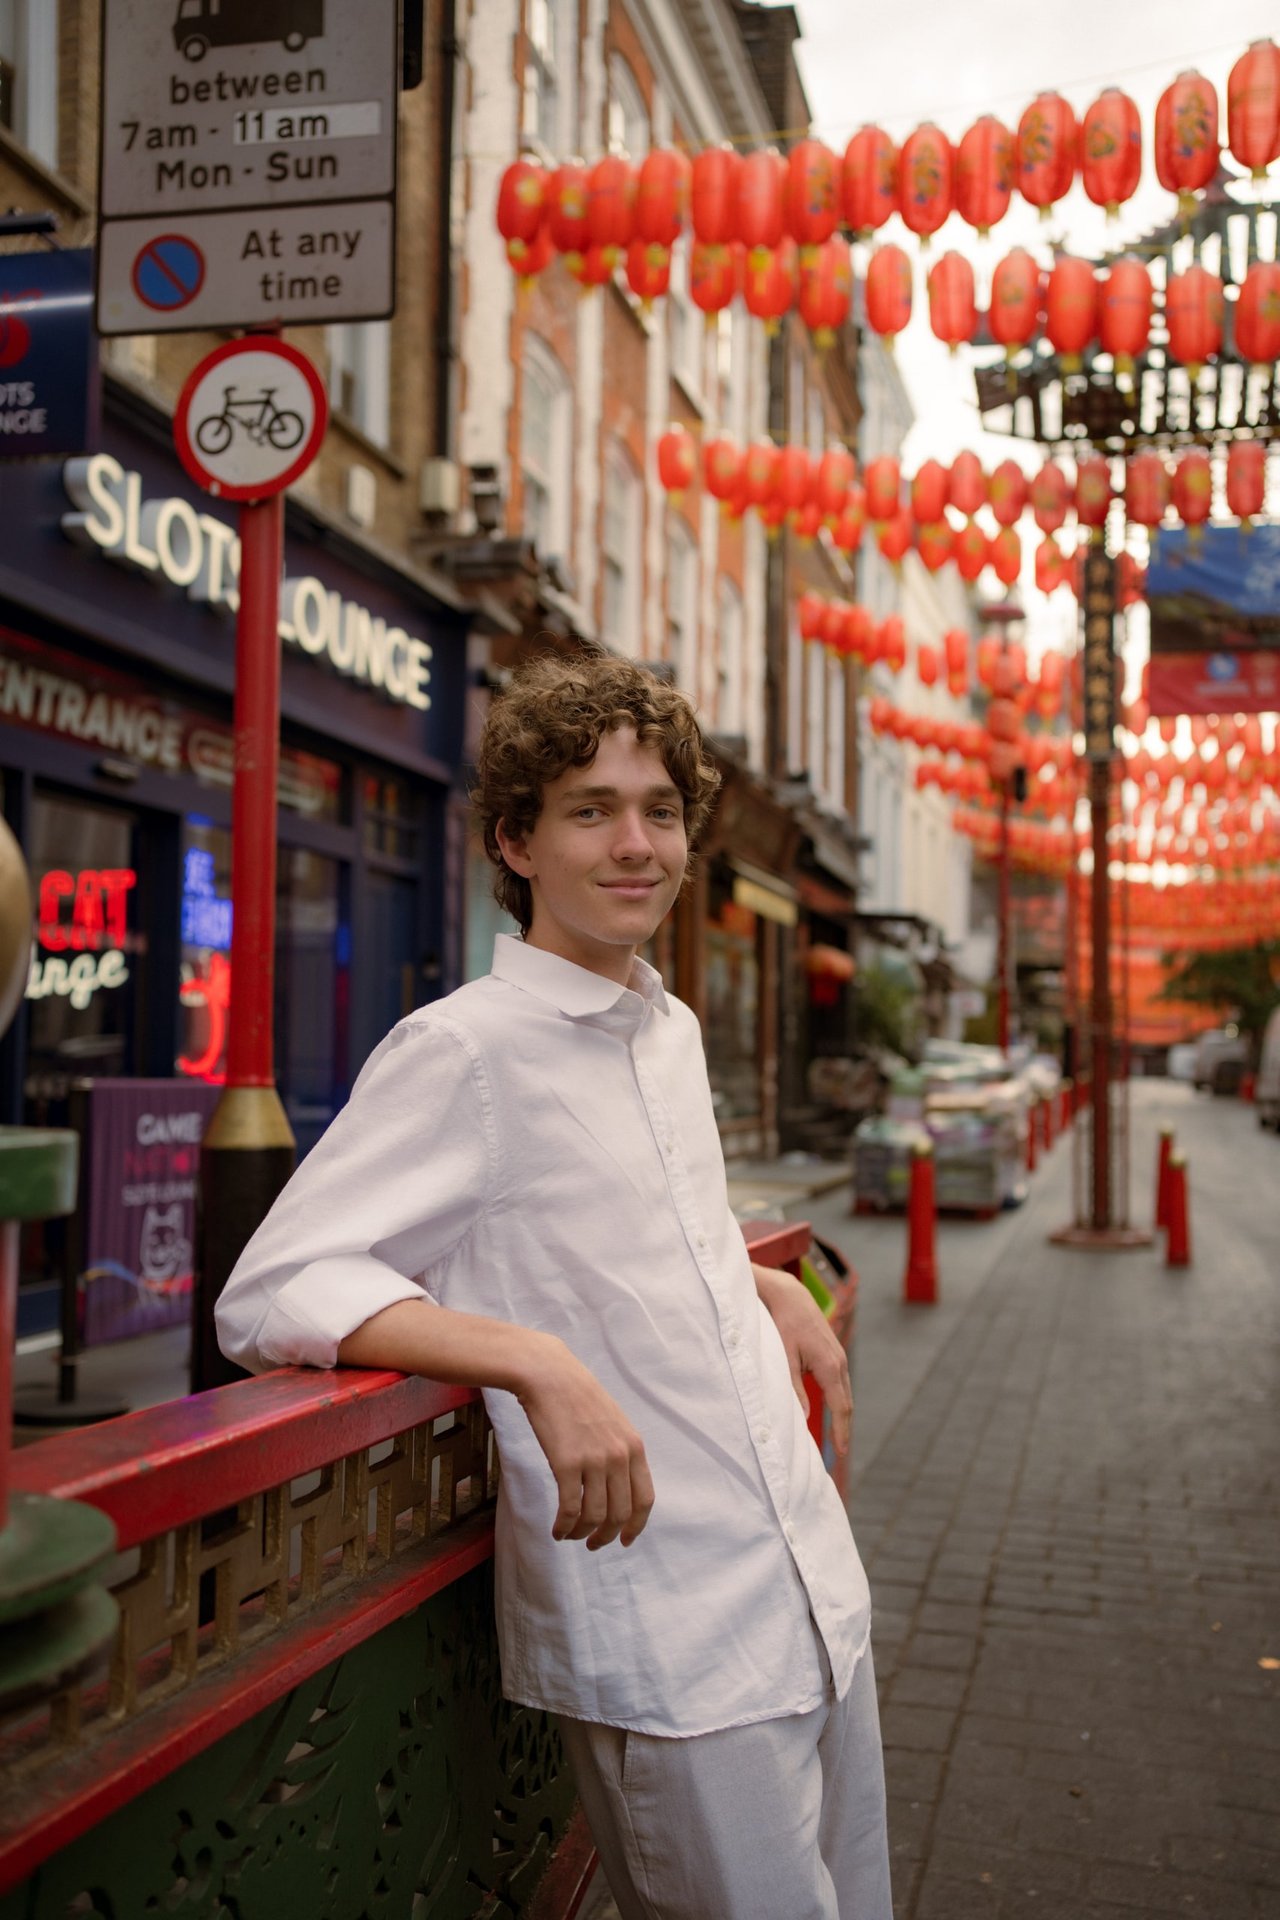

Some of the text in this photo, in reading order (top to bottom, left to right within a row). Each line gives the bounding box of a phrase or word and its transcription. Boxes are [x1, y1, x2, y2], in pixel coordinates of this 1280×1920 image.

[170, 68, 326, 105] between
[156, 161, 231, 192] Mon
[266, 152, 338, 182] Sun
[240, 229, 361, 260] At any
[260, 272, 341, 301] time
[40, 868, 136, 952] CAT
